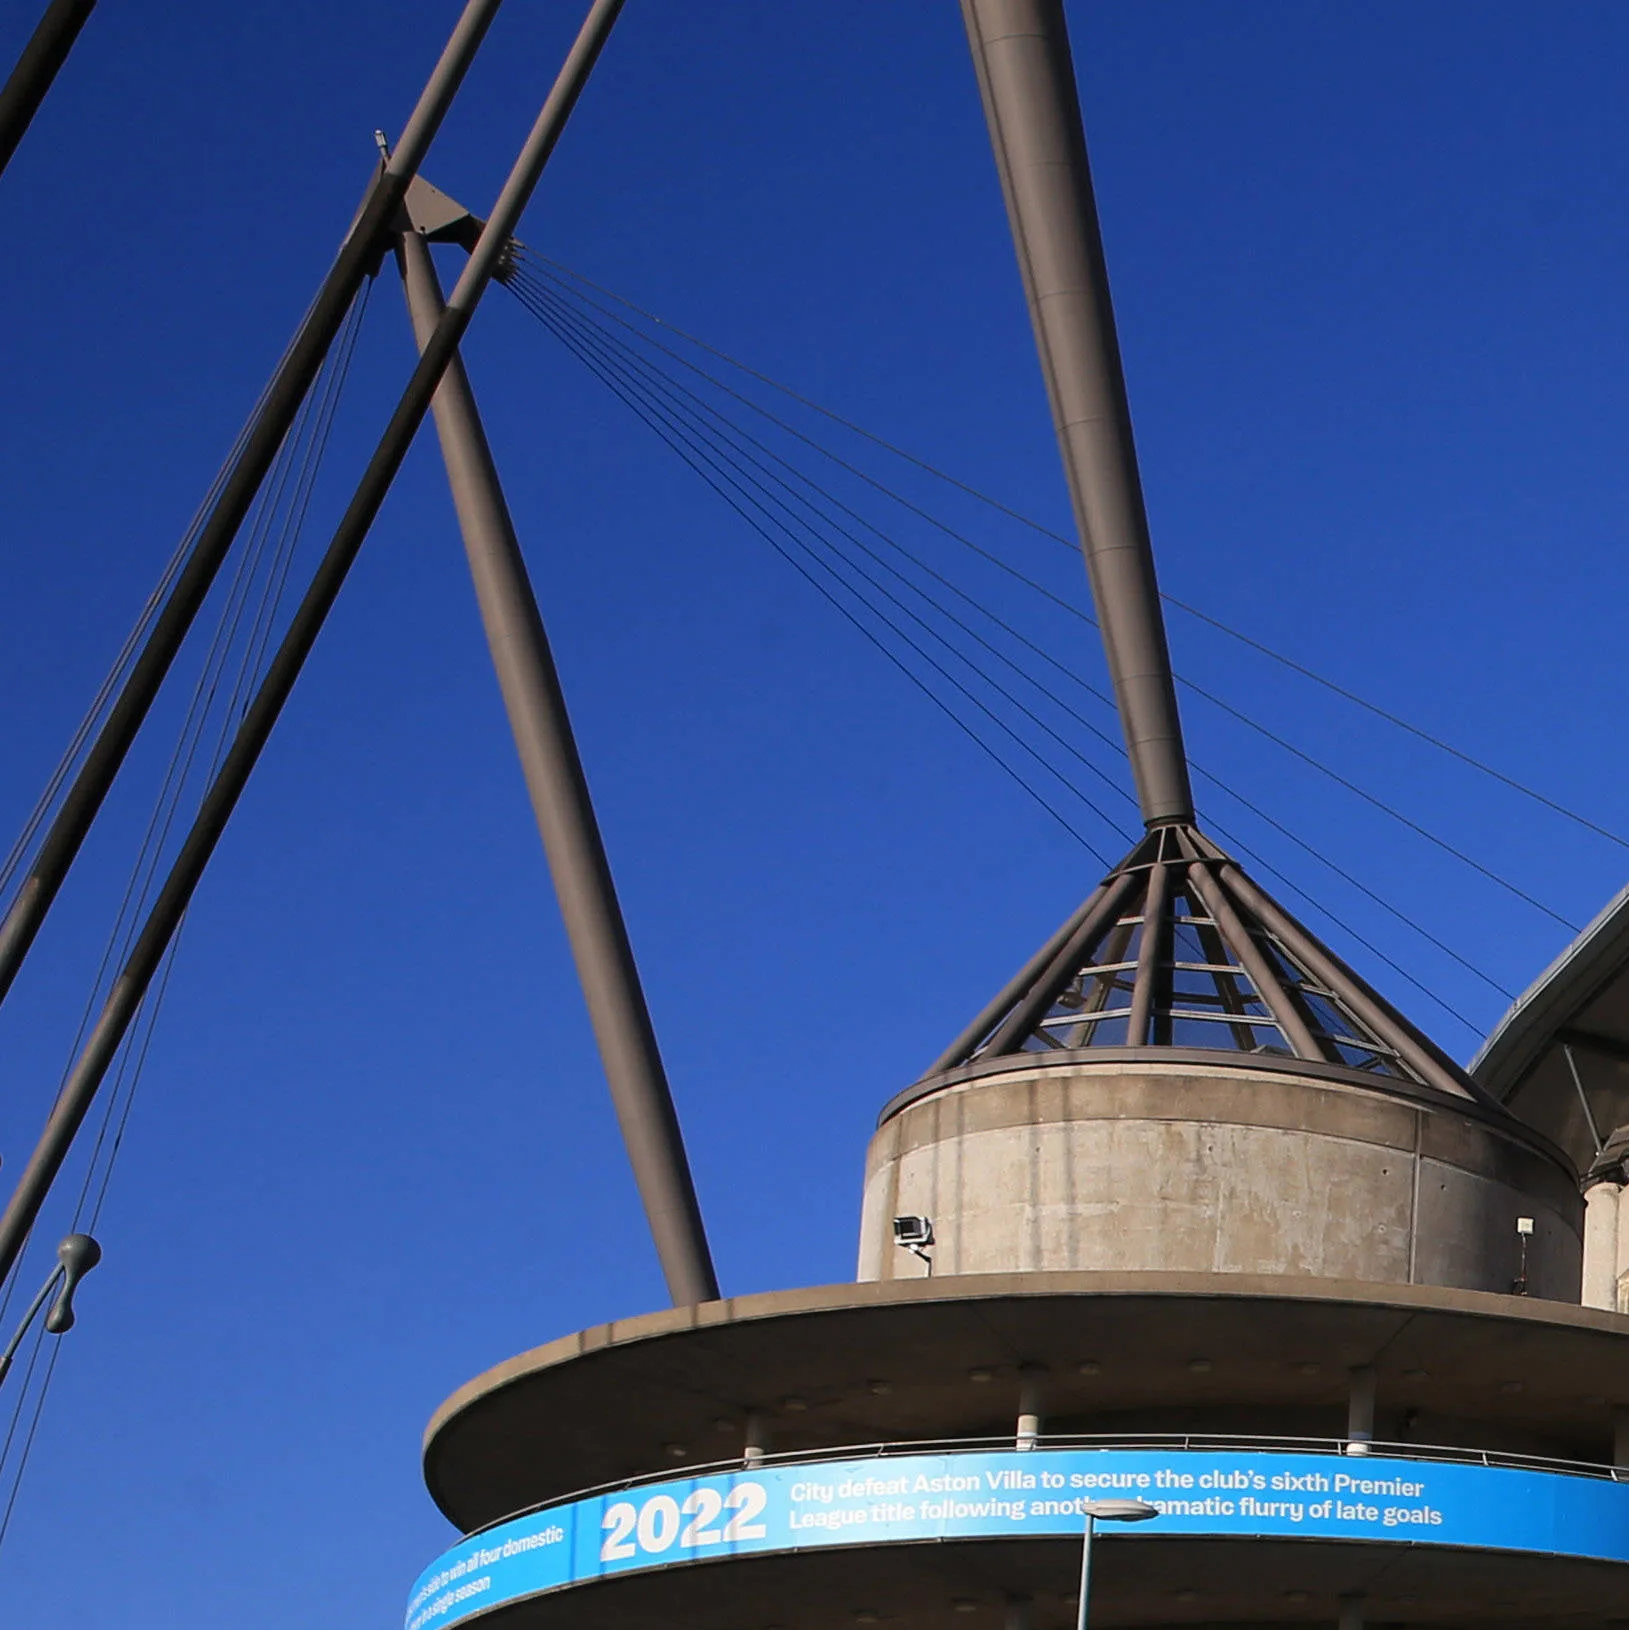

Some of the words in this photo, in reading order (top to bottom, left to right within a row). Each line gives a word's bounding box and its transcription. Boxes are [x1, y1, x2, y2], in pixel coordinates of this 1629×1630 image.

[790, 1482, 834, 1504] City
[837, 1476, 907, 1499] defeat
[910, 1474, 980, 1494] Aston
[985, 1470, 1035, 1490] Villa
[1040, 1472, 1064, 1489] to
[1069, 1473, 1150, 1490] secure
[1155, 1470, 1194, 1489] the
[1199, 1470, 1266, 1490] club's
[1271, 1472, 1330, 1493] sixth
[1334, 1474, 1425, 1497] Premier
[600, 1481, 767, 1562] 2022
[789, 1508, 868, 1530] League
[871, 1500, 913, 1522] title
[920, 1498, 1025, 1520] following
[1239, 1497, 1303, 1521] flurry
[1309, 1500, 1333, 1518] of
[1336, 1499, 1378, 1520] late
[1383, 1504, 1442, 1526] goals
[503, 1526, 564, 1557] domestic
